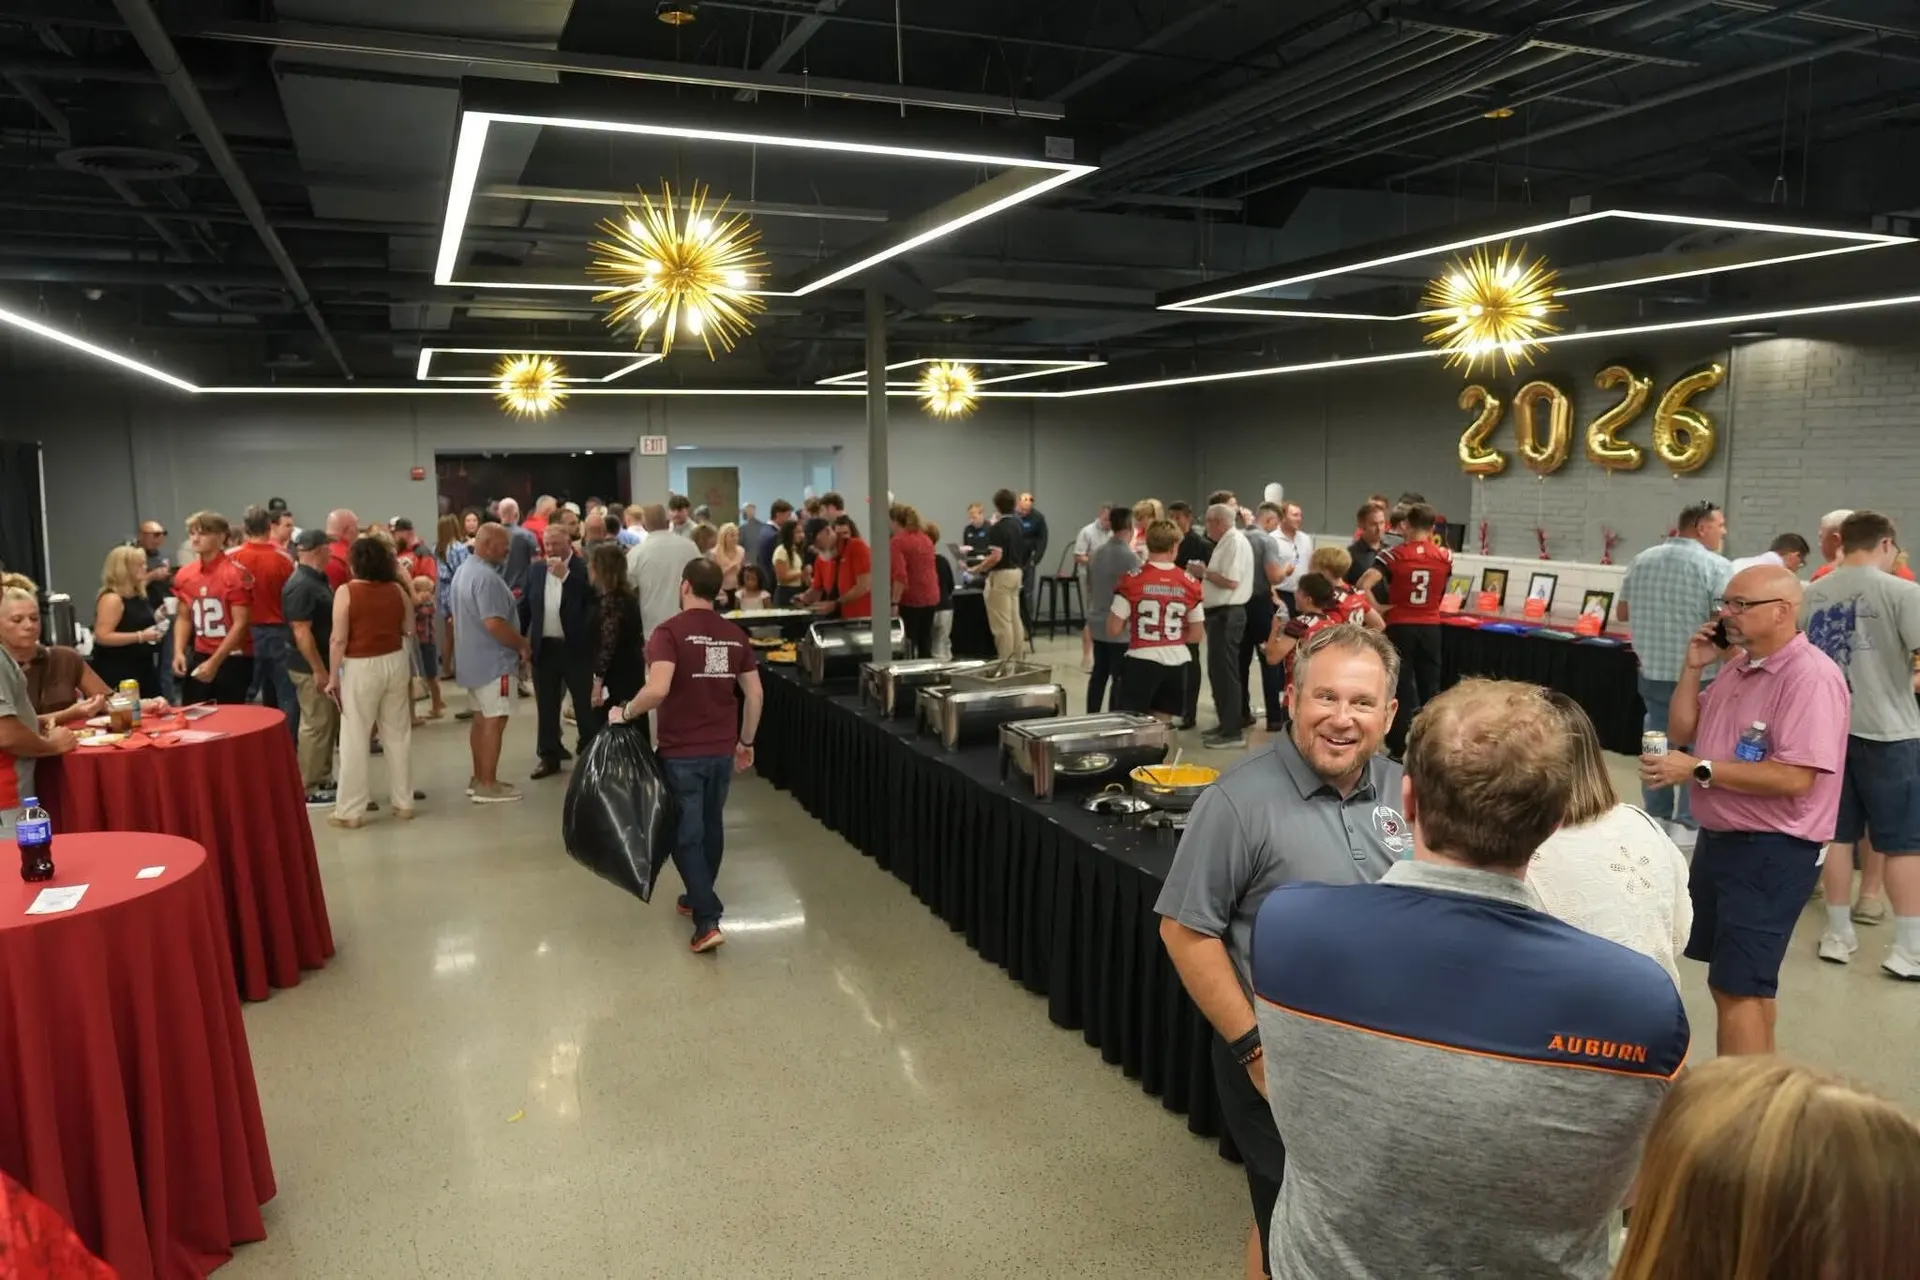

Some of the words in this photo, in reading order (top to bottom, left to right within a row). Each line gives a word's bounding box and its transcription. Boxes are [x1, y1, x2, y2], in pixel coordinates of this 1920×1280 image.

[1457, 362, 1726, 475] 2026
[644, 438, 664, 453] EXIT
[1410, 570, 1430, 604] 3
[192, 597, 227, 637] 12
[1137, 599, 1187, 641] 26
[1547, 1033, 1648, 1063] AUBURN
